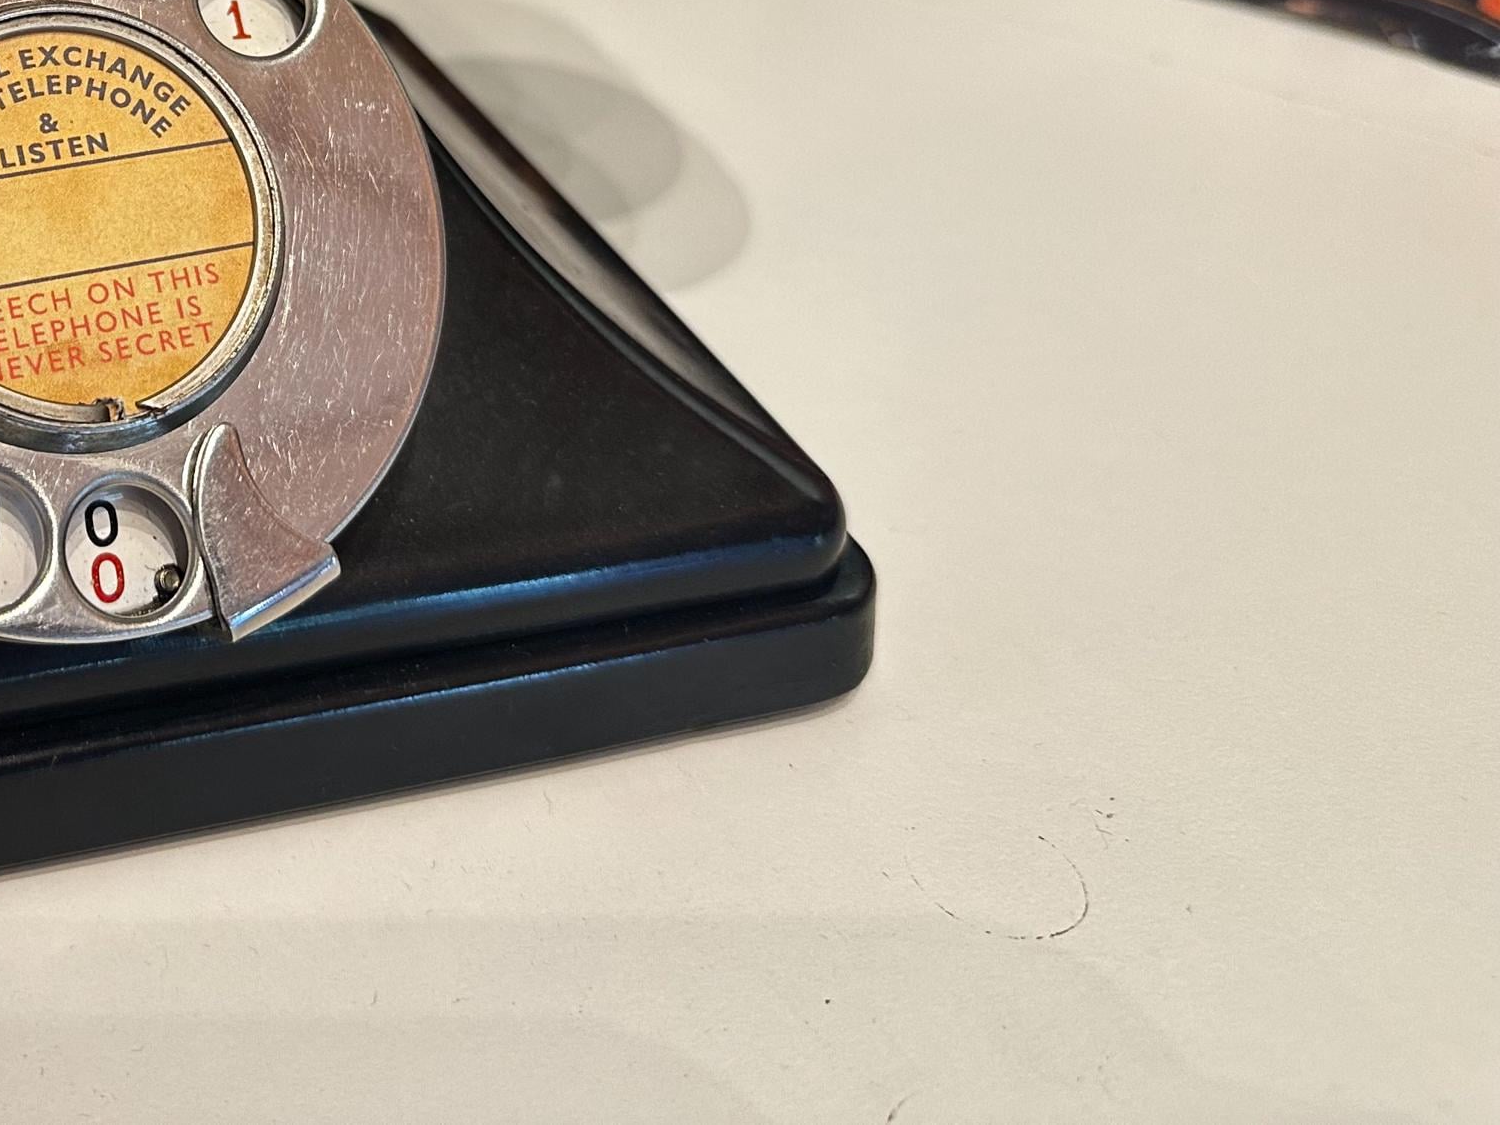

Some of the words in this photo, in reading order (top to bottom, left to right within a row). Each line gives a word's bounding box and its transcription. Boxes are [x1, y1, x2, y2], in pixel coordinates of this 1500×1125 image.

[226, 0, 252, 40] 1
[18, 45, 191, 118] EXCHANGE
[38, 112, 59, 134] &
[87, 277, 135, 305] ON
[147, 262, 220, 294] THIS
[176, 295, 203, 318] IS
[99, 321, 214, 364] SECRET
